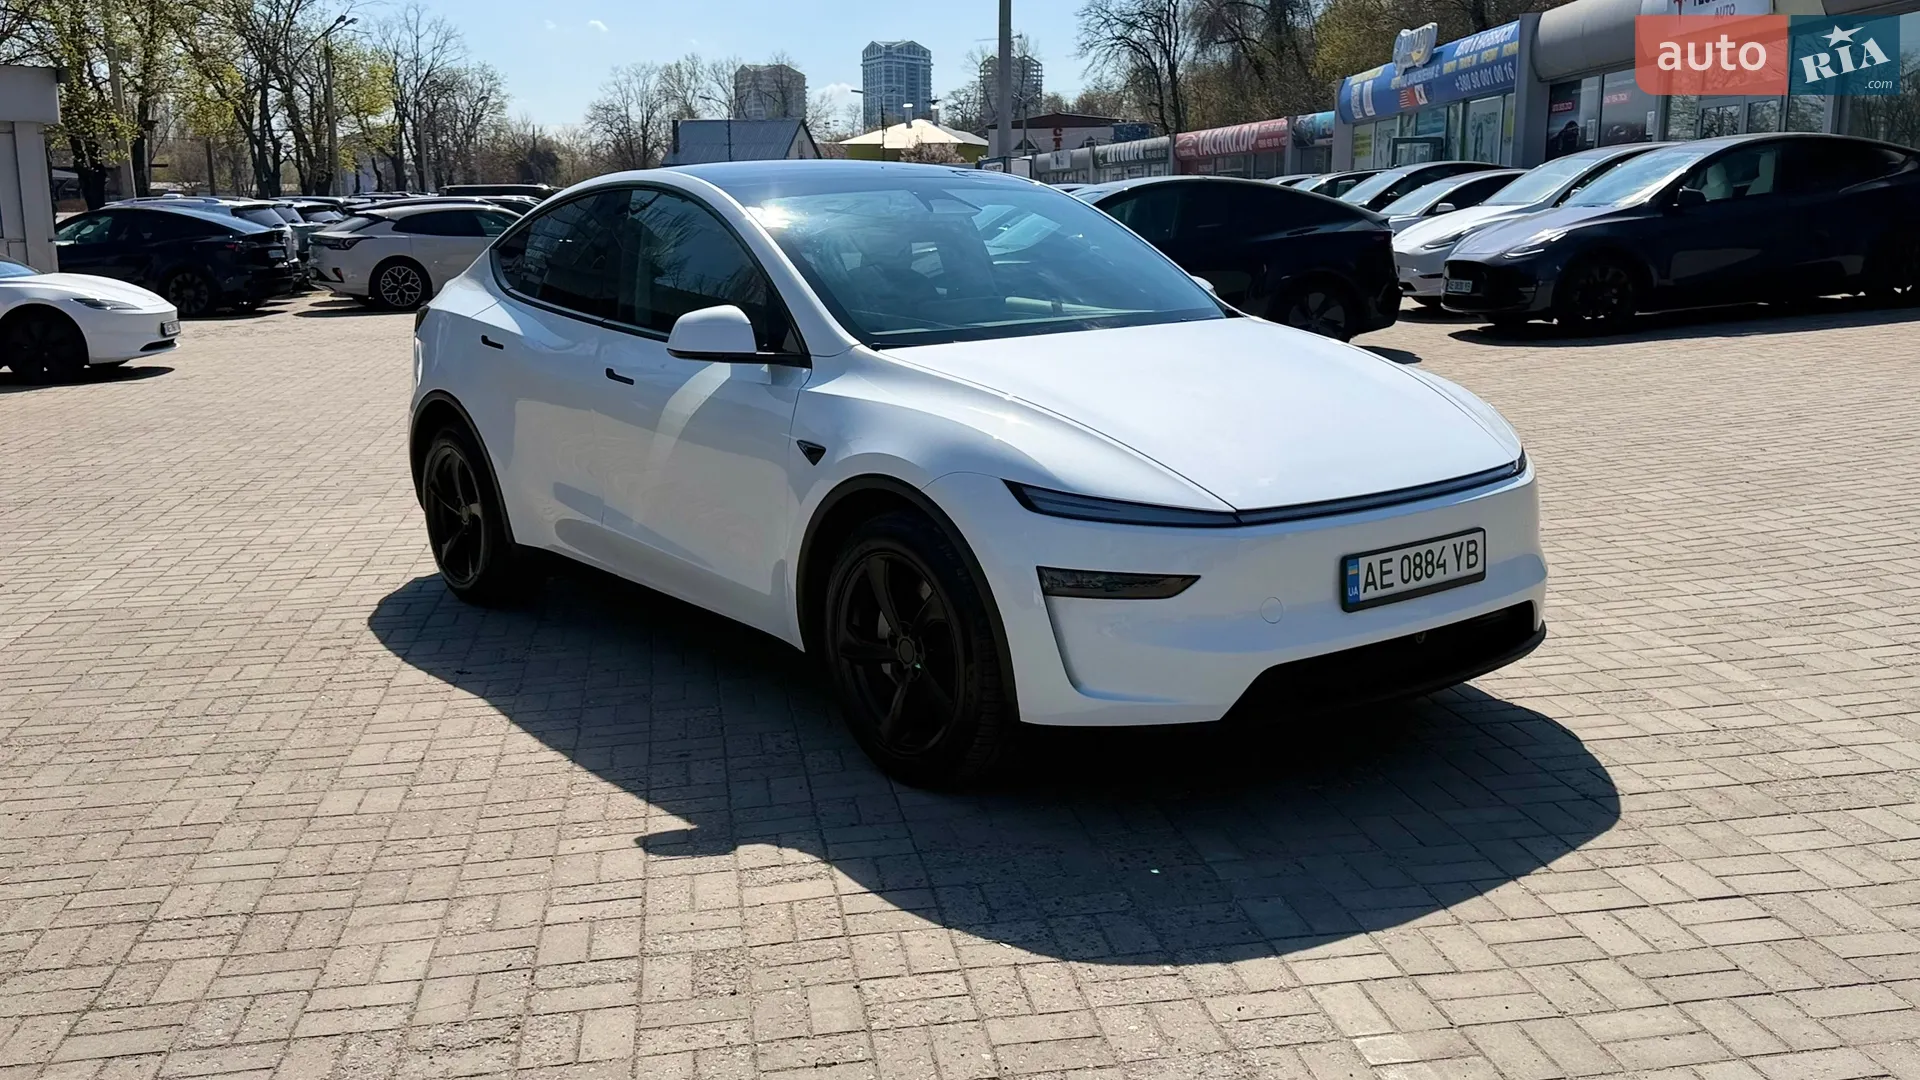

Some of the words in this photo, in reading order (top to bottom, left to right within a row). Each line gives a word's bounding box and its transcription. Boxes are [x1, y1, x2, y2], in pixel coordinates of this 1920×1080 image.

[1504, 61, 1514, 80] 16
[1362, 557, 1395, 594] AE
[1400, 545, 1447, 585] 0884
[1452, 539, 1479, 572] YB
[1348, 586, 1359, 597] UA
